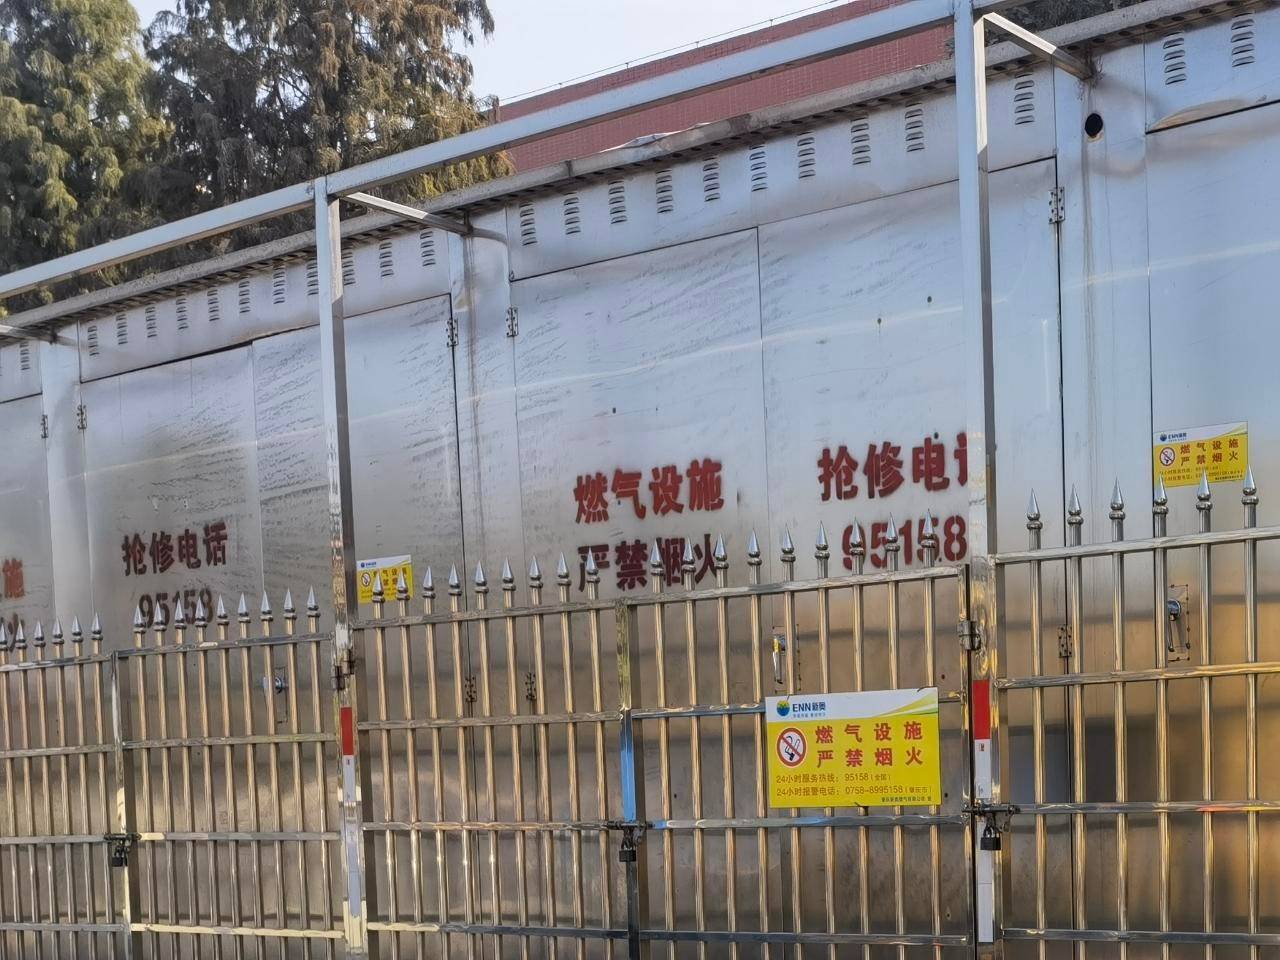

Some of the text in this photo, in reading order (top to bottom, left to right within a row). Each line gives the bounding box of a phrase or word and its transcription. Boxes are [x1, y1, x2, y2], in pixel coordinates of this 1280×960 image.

[573, 457, 725, 525] 燃气设施
[121, 521, 228, 577] 抢修电话
[842, 514, 968, 571] 95158
[815, 720, 923, 744] 燃气设施
[816, 746, 923, 768] 严禁烟火
